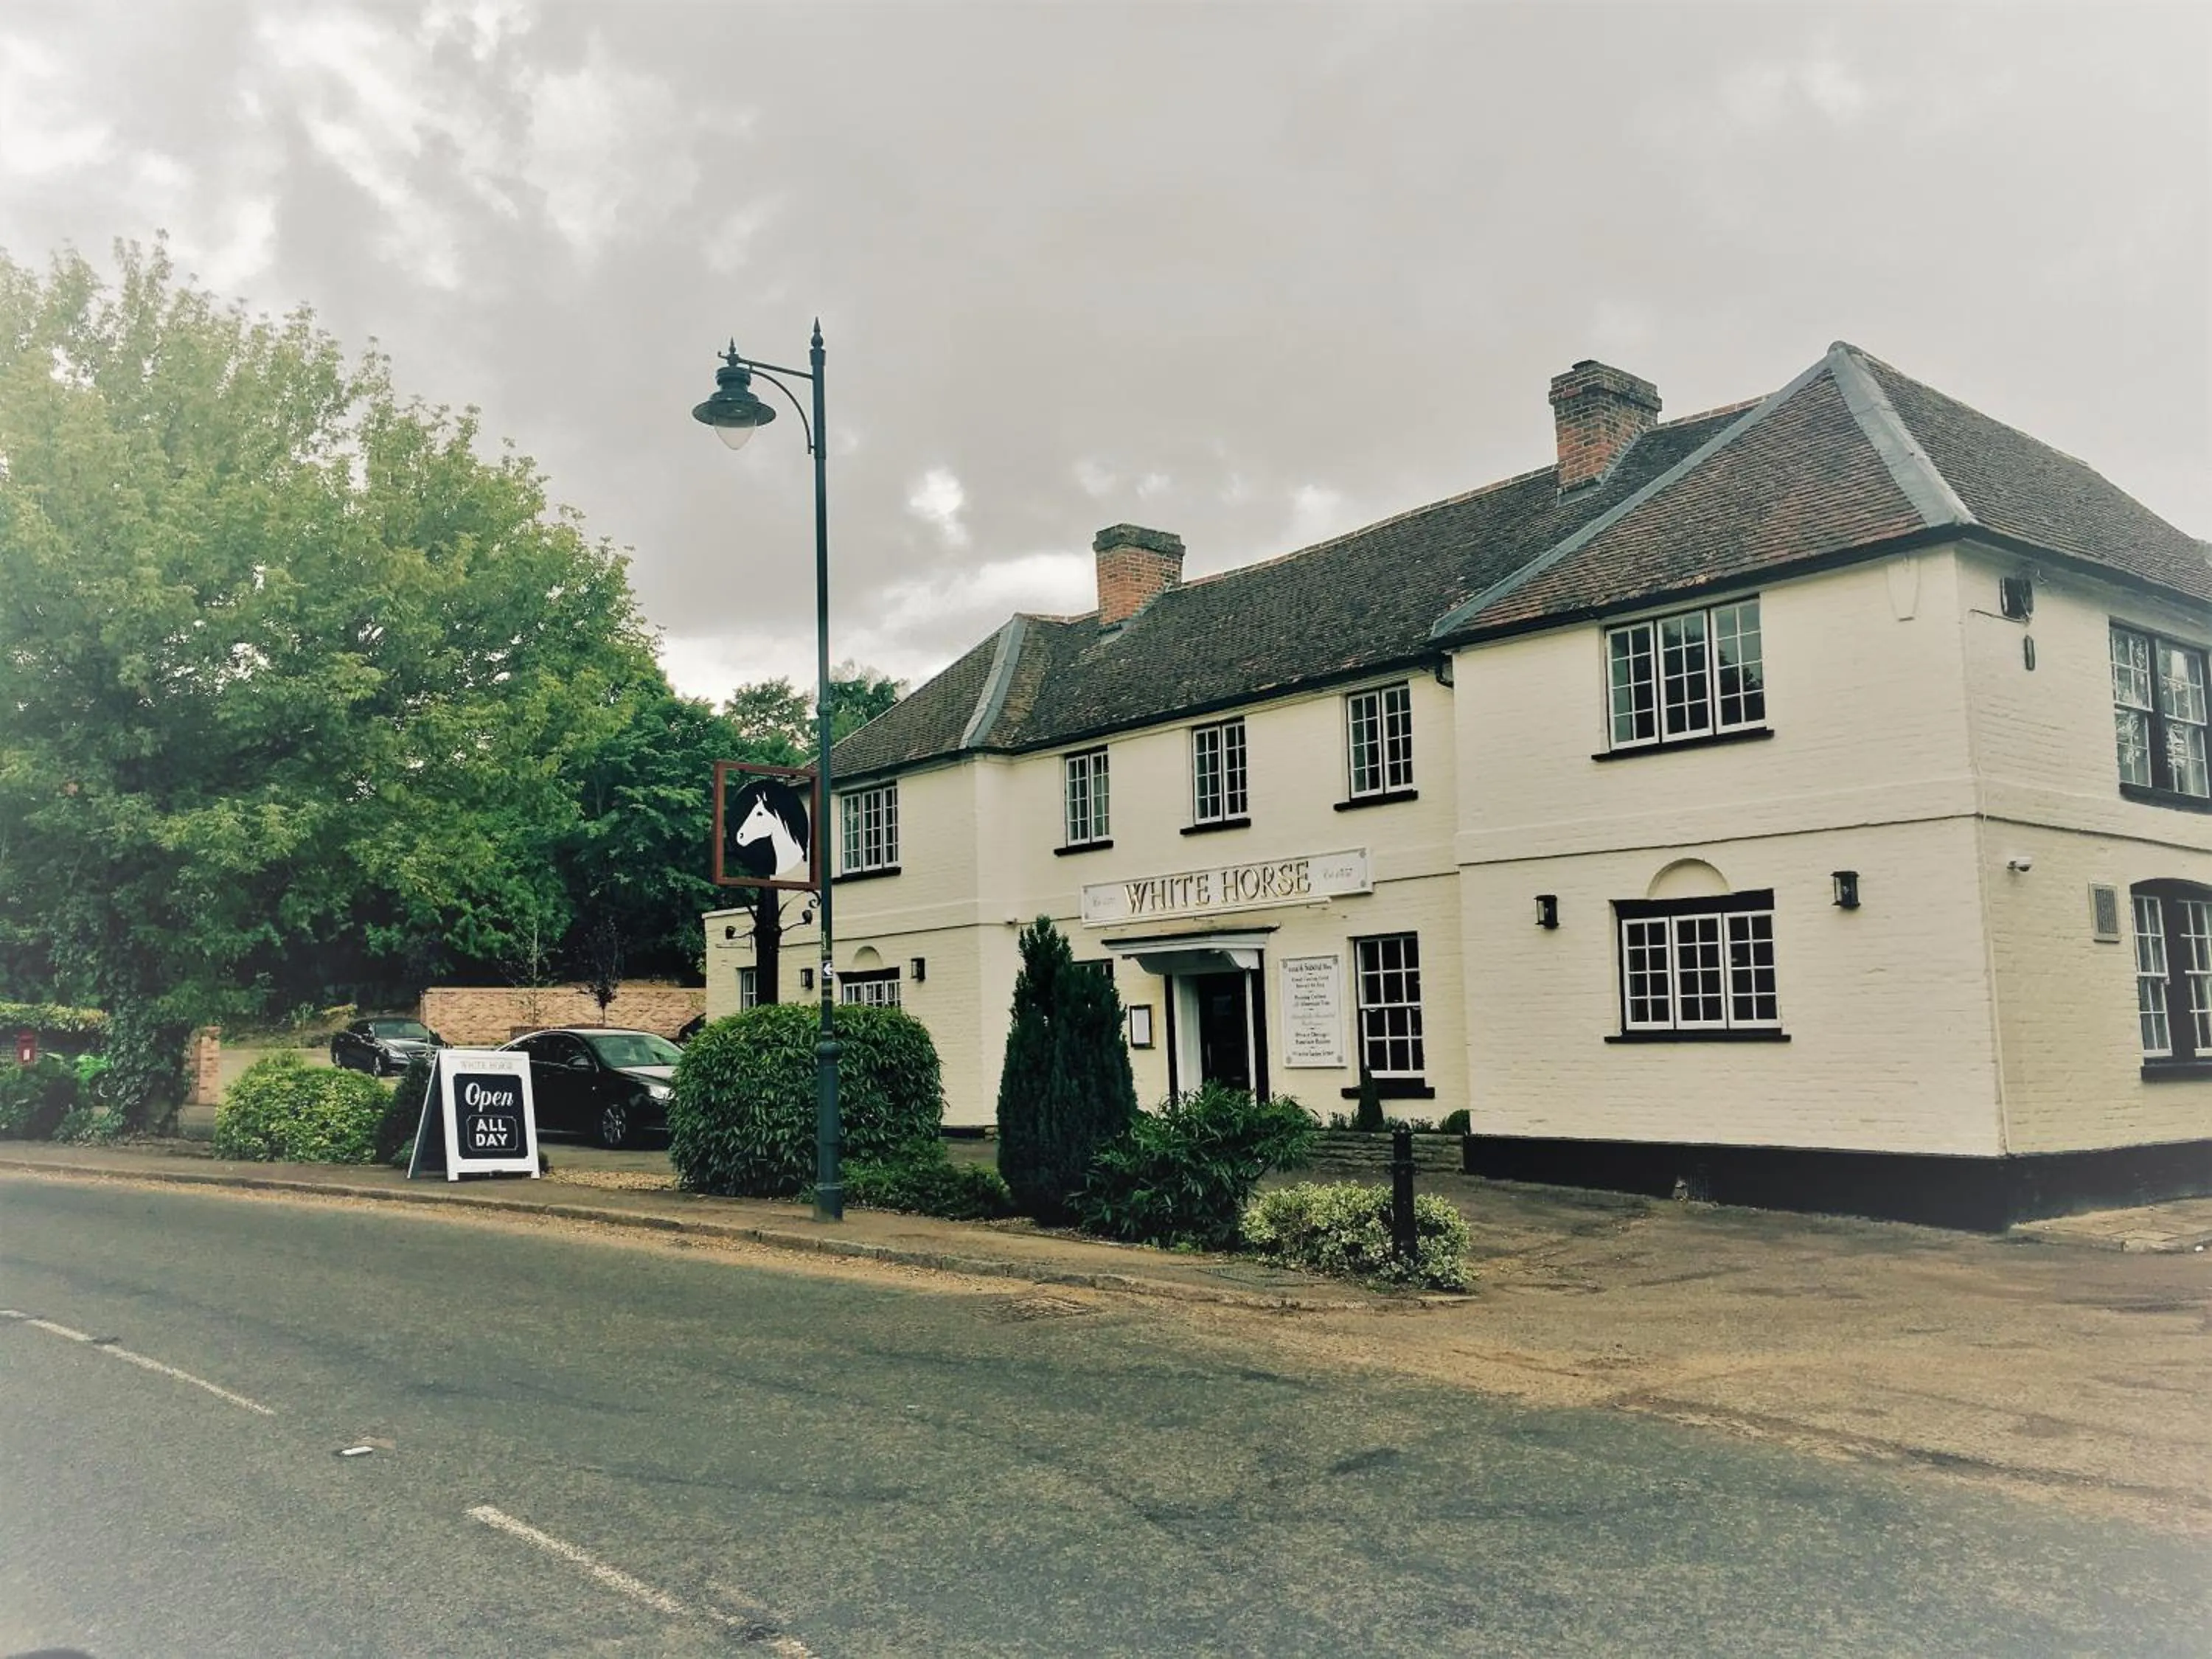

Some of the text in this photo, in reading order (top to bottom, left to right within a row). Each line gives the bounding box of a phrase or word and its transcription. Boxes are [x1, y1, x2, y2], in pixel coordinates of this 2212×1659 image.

[1125, 860, 1312, 914] WHITE HORSE
[459, 1061, 486, 1070] WHITE
[465, 1082, 514, 1113] Open
[476, 1119, 507, 1132] ALL
[476, 1133, 508, 1147] DAY
